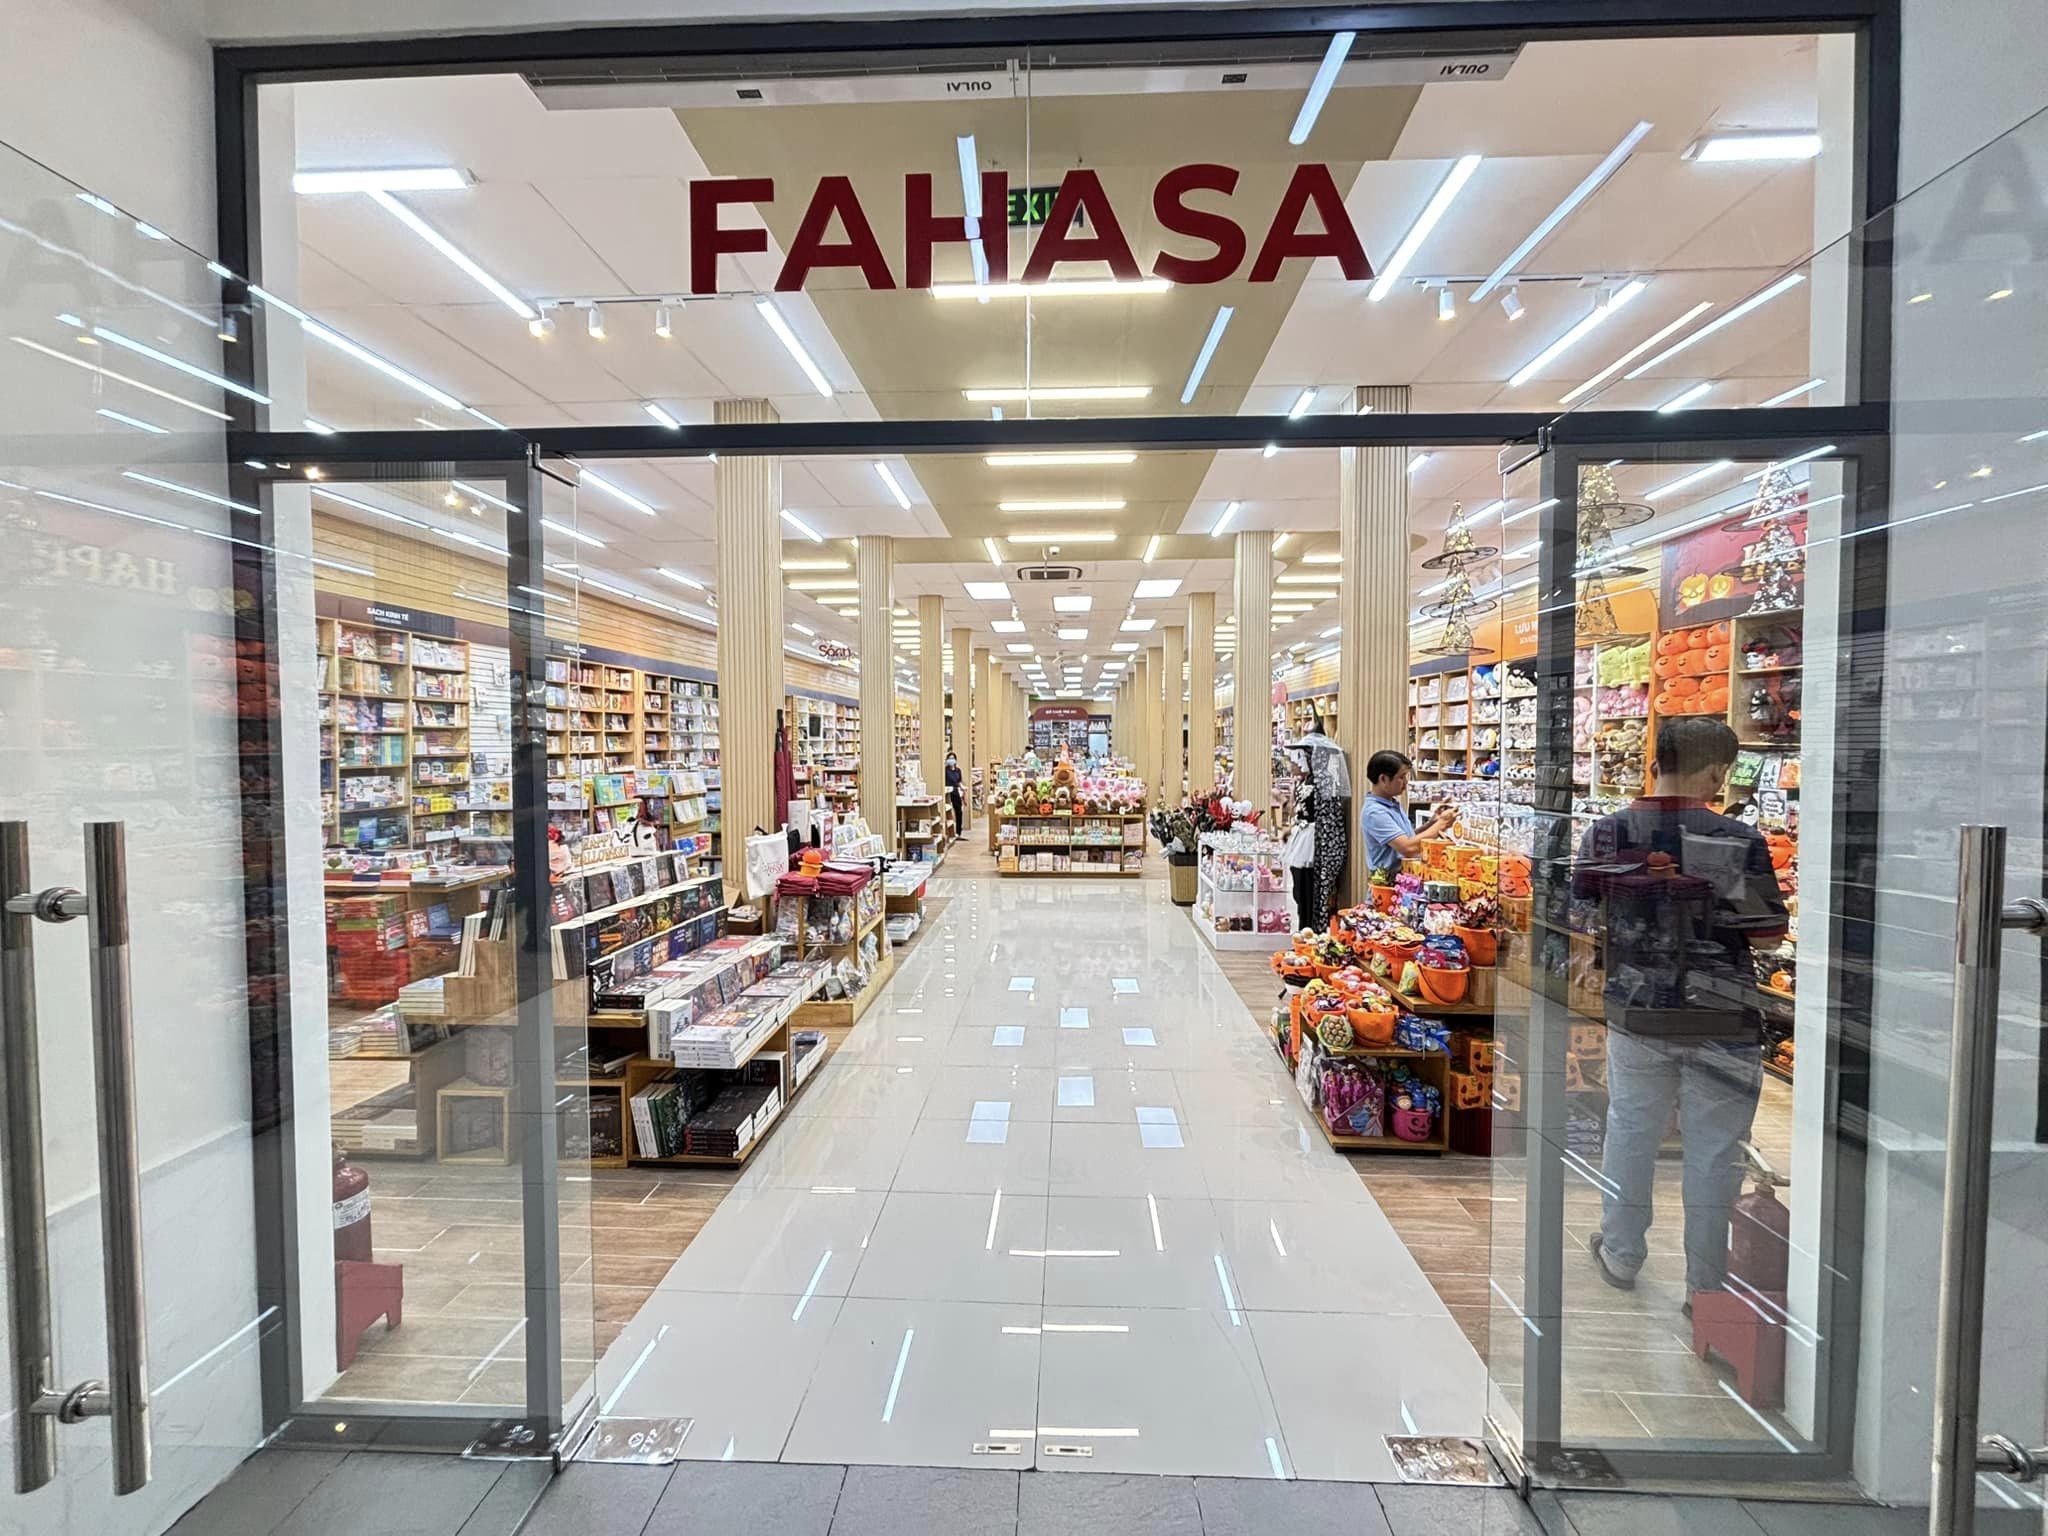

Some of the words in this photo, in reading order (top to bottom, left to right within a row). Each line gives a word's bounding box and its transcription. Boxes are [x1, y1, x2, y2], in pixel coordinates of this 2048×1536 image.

[1440, 64, 1489, 76] OULAI
[947, 81, 992, 92] OULAI
[1008, 192, 1059, 222] EXI
[690, 163, 1375, 294] FAHASA
